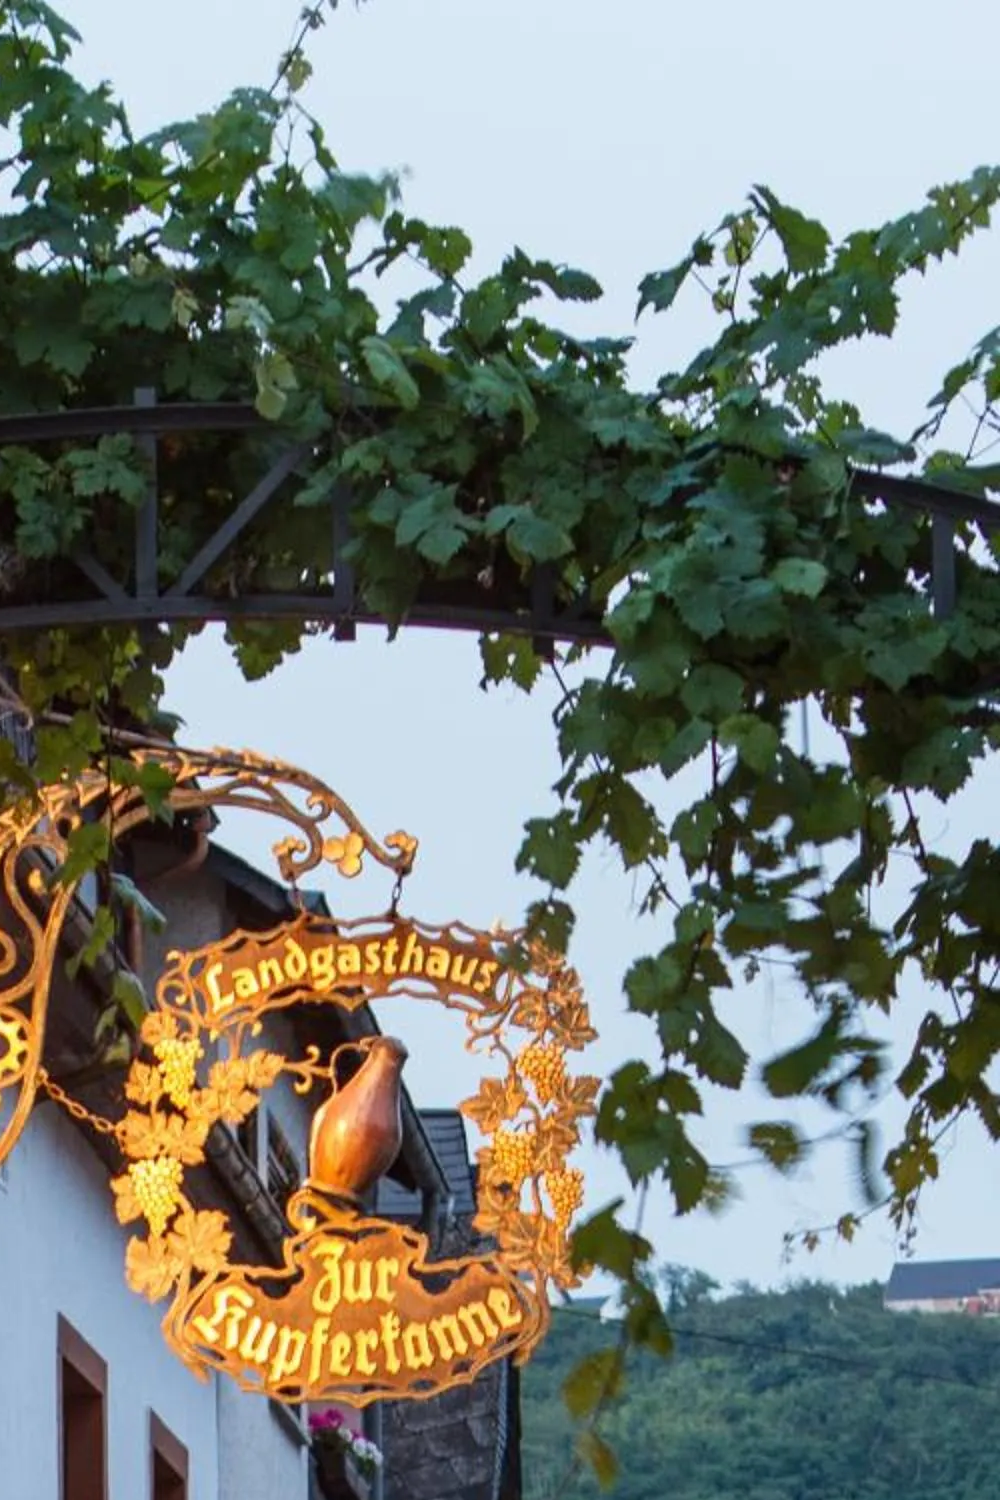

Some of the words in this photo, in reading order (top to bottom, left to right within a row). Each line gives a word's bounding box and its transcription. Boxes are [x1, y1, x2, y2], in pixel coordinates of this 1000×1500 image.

[205, 932, 498, 1009] Landgasthaus
[311, 1239, 399, 1311] Zur
[194, 1286, 522, 1384] Kupferkanne
